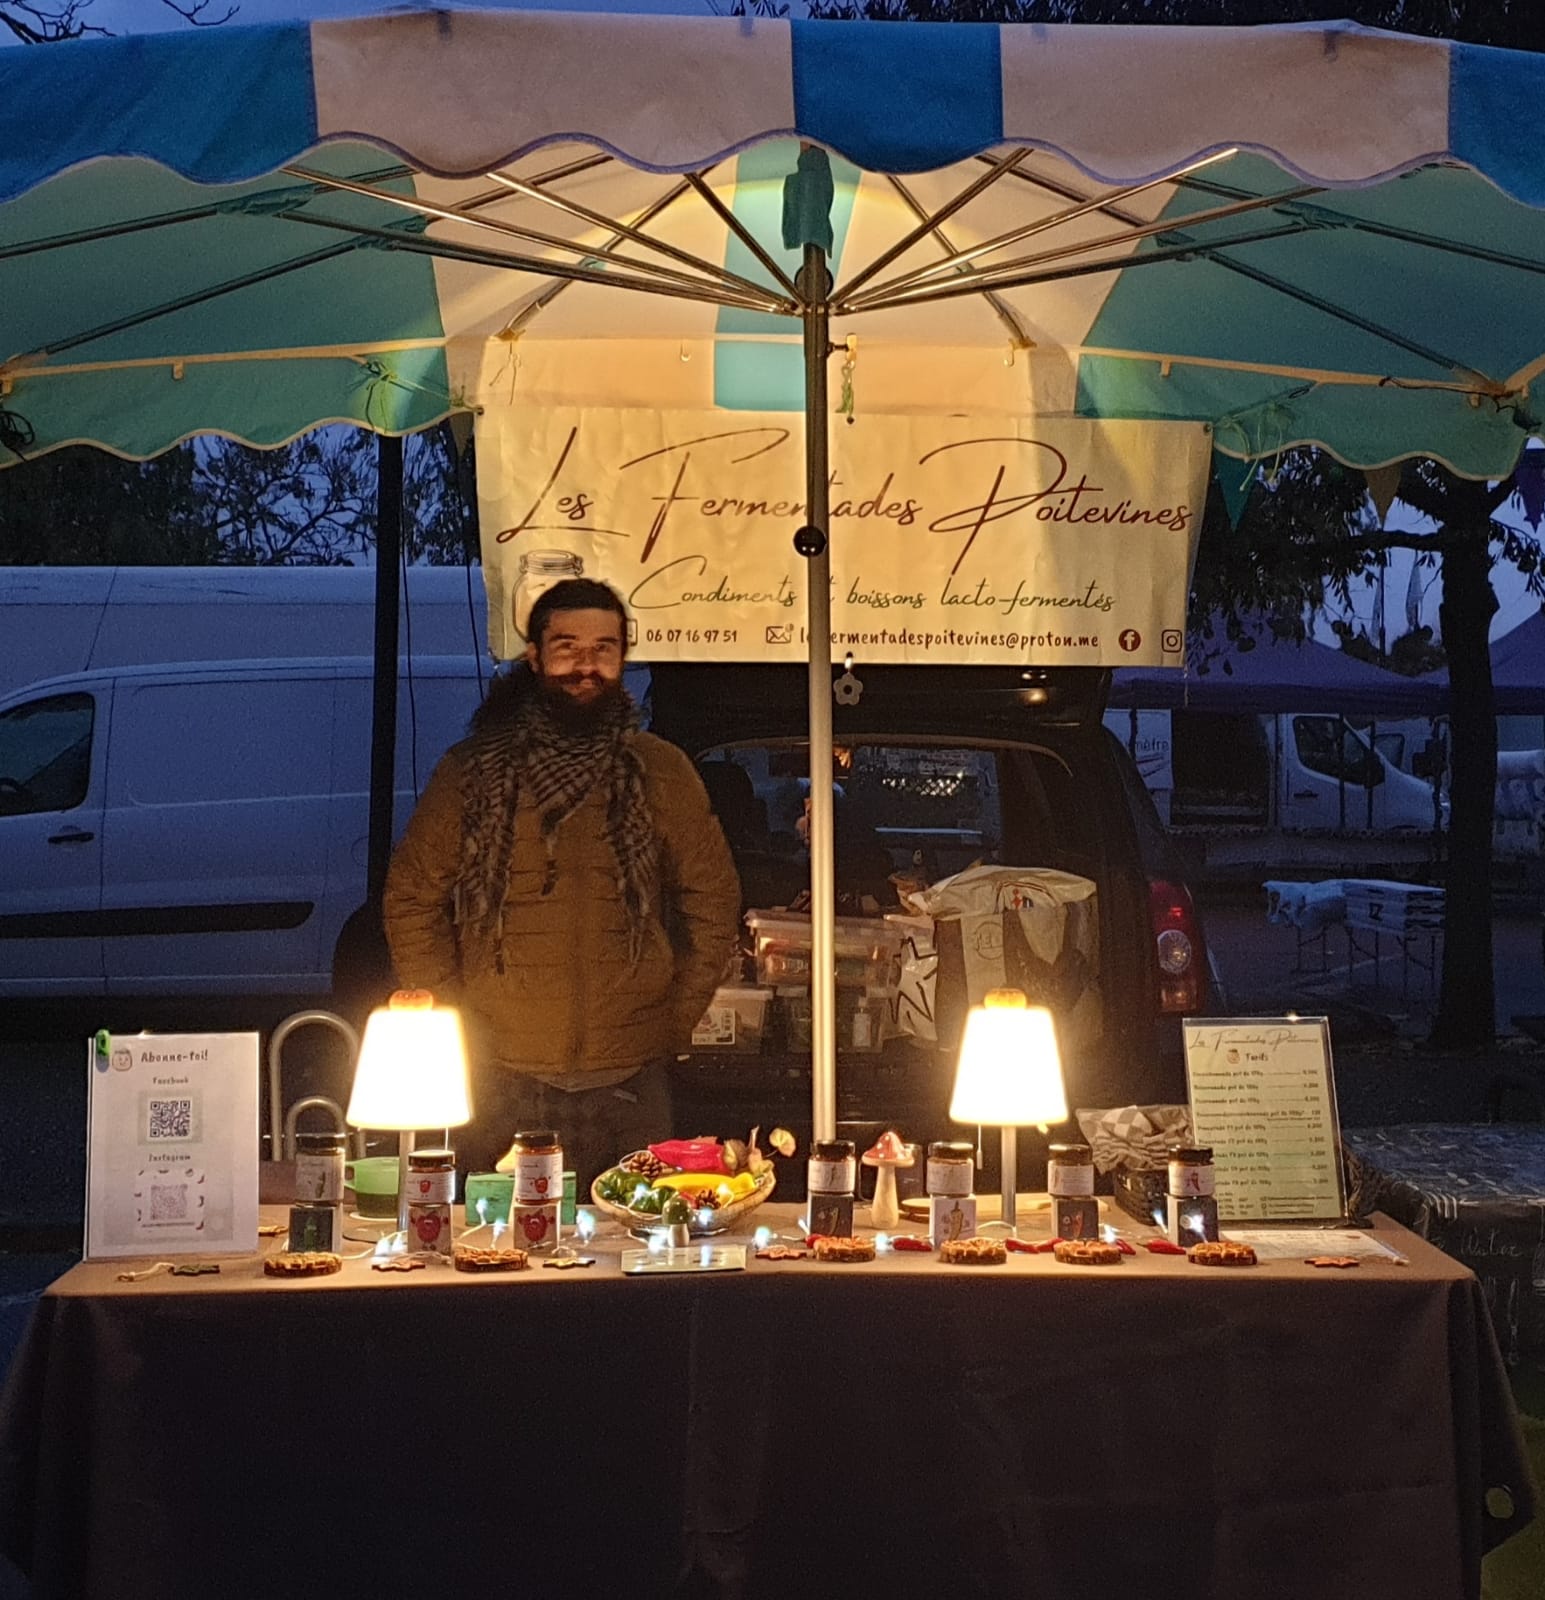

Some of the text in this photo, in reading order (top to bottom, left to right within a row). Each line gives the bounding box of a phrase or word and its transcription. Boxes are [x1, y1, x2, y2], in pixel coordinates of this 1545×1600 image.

[496, 427, 630, 543] Les
[919, 438, 1193, 576] Poitevines
[628, 555, 798, 608] Condiments
[846, 576, 927, 609] boissons
[646, 629, 663, 643] 06
[667, 629, 682, 643] 07
[686, 629, 700, 643] 16
[703, 629, 719, 643] 97
[723, 629, 737, 643] 51
[141, 1048, 208, 1063] Abonne-toi!
